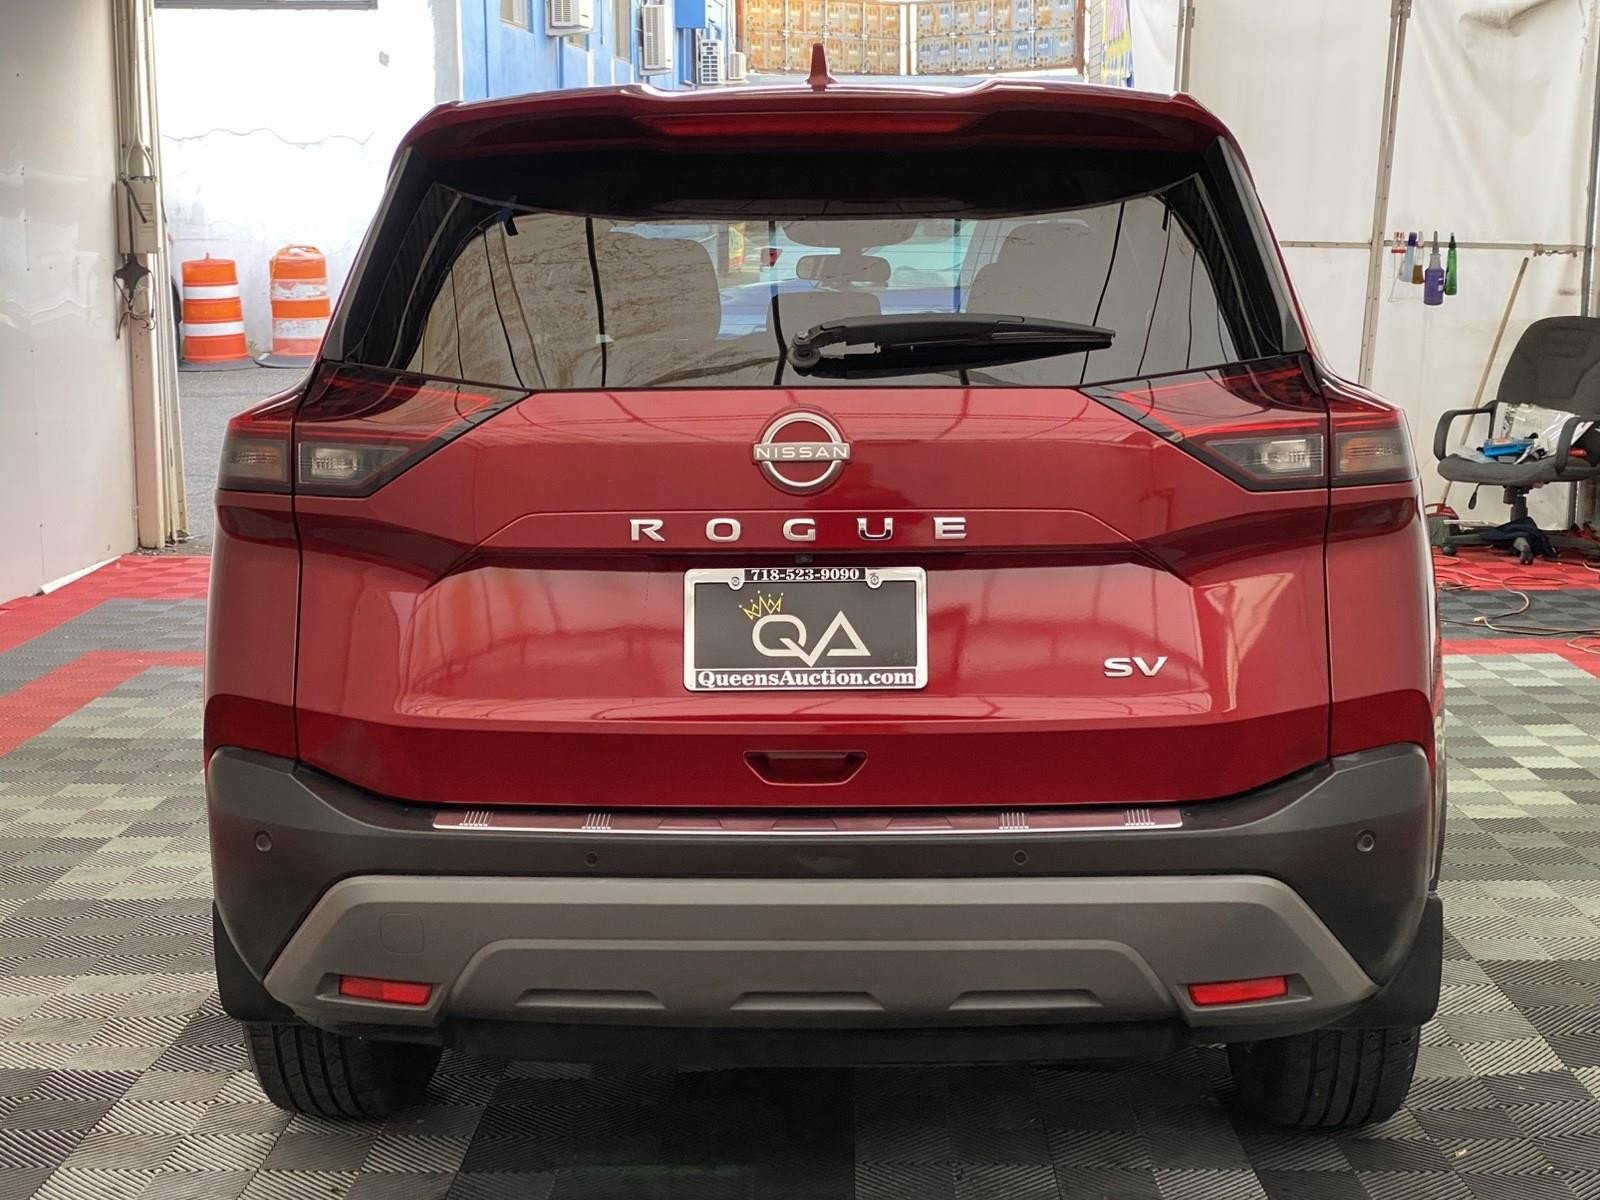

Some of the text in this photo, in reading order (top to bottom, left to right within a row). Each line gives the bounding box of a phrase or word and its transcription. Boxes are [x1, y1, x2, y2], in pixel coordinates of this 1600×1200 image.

[755, 446, 849, 459] NISSAN
[629, 517, 966, 542] ROGUE
[750, 568, 860, 581] 718-523-9090
[752, 610, 872, 667] QA
[1103, 656, 1168, 677] SV
[697, 670, 914, 688] QueensAuction.com
